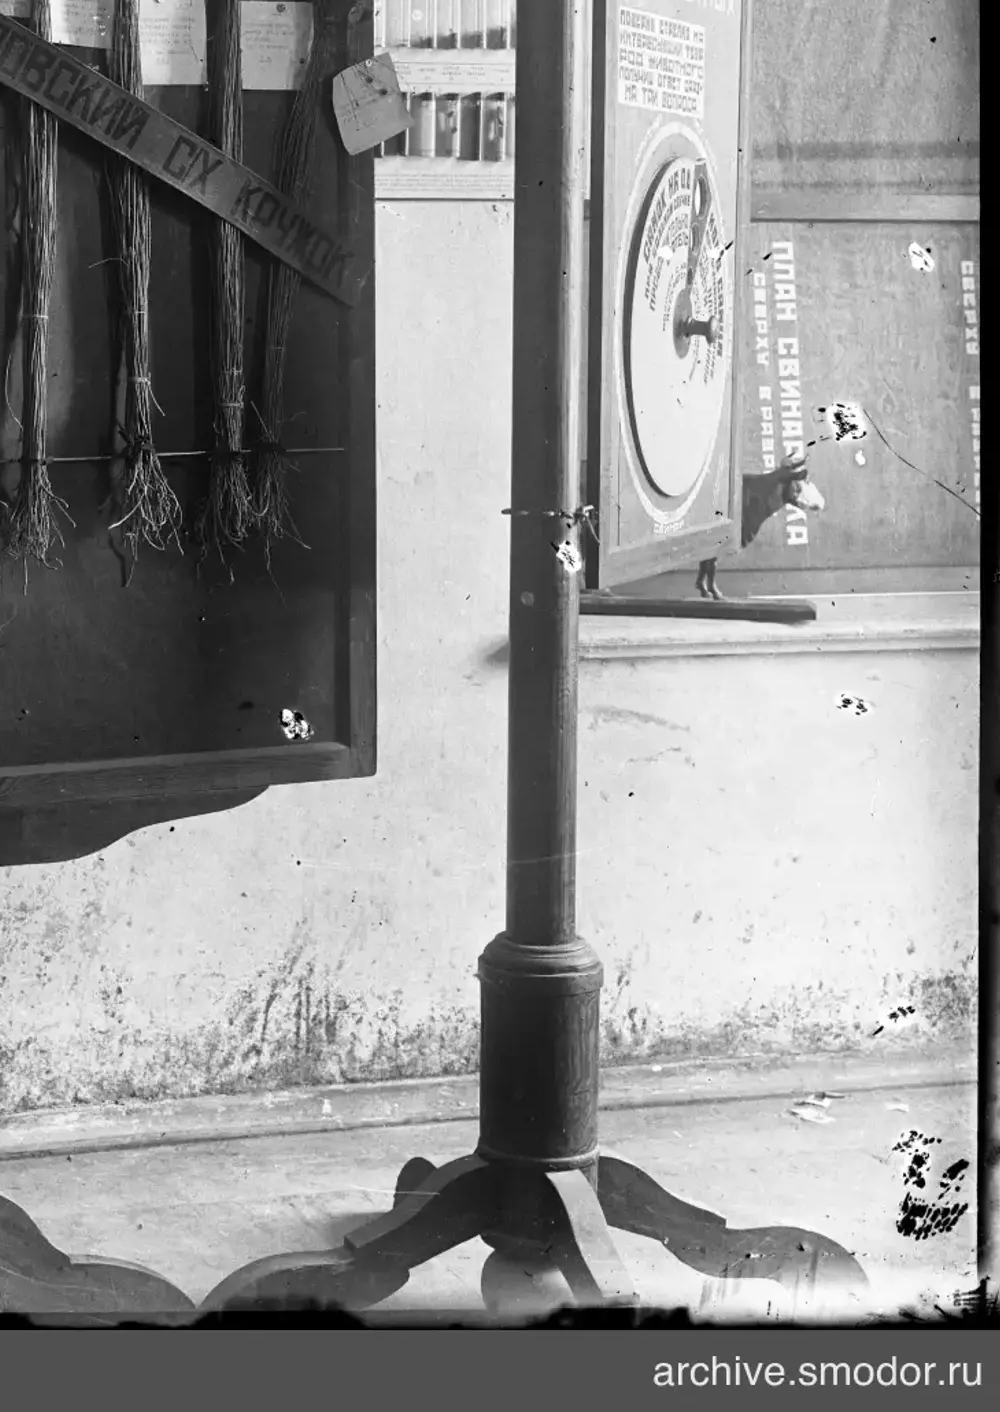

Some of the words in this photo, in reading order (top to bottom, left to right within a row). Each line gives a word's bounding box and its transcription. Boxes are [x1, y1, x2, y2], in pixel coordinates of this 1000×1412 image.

[752, 272, 770, 366] СВЕРХУ
[772, 241, 798, 321] ПЛАН
[961, 260, 980, 355] СВЕРХУ
